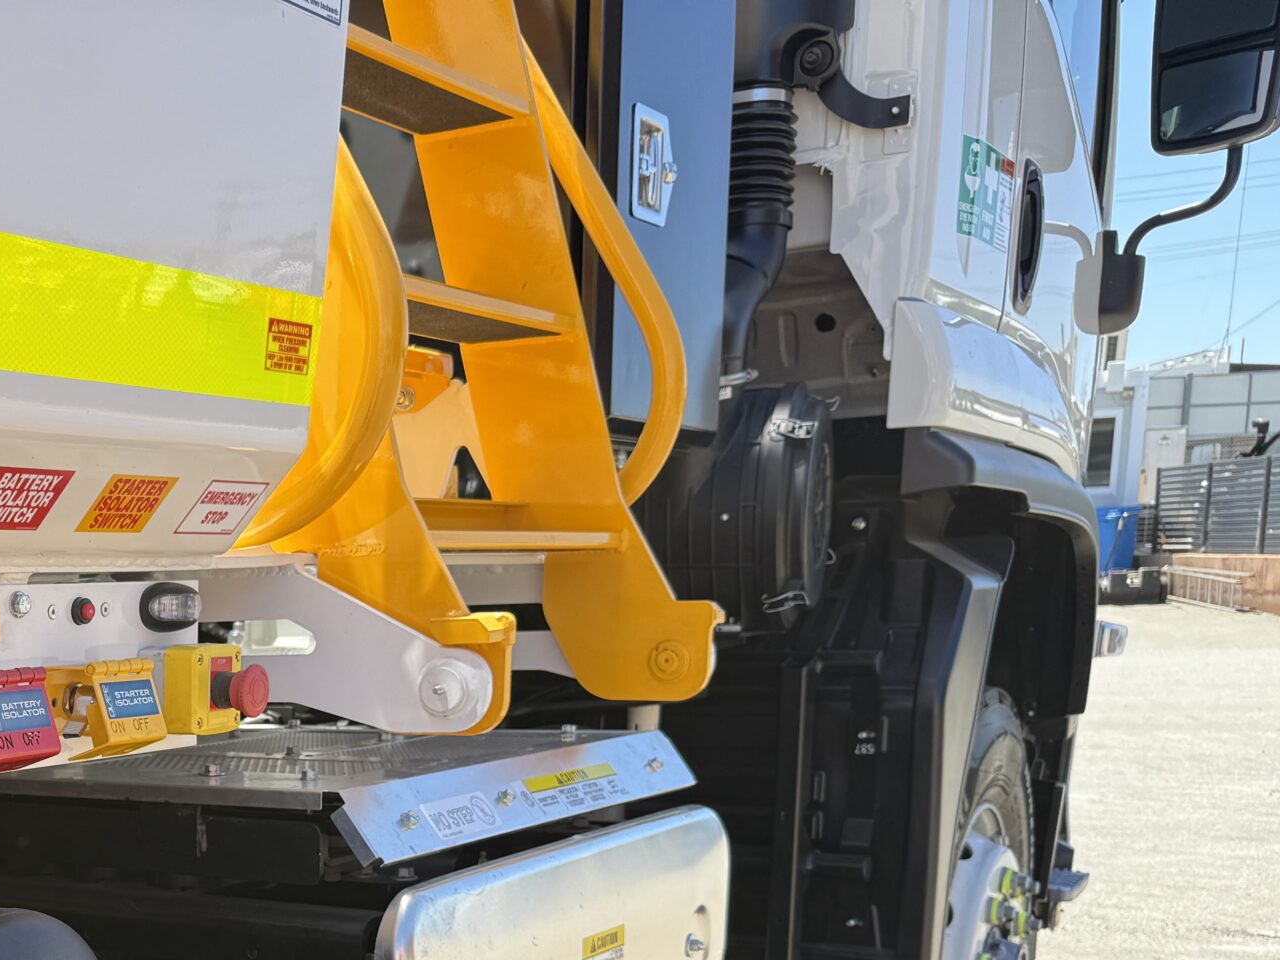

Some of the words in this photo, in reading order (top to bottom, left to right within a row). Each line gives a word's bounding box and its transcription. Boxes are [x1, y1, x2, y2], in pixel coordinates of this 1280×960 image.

[279, 323, 310, 336] WARNING
[109, 478, 169, 496] STARTER
[93, 495, 160, 513] ISOLATOR
[200, 490, 258, 507] EMERGENCY
[89, 513, 142, 529] SWITCH
[200, 511, 228, 525] STOP
[114, 688, 150, 699] STARTER
[115, 696, 154, 707] ISOLATOR
[1, 699, 41, 711] BATTERY
[1, 708, 46, 720] ISOLATOR
[110, 721, 126, 734] ON
[133, 717, 149, 731] OFF
[22, 730, 40, 746] OFF
[560, 768, 588, 783] CAUTION
[429, 811, 451, 832] NO
[447, 805, 476, 827] STEP
[597, 931, 618, 950] CAUTION
